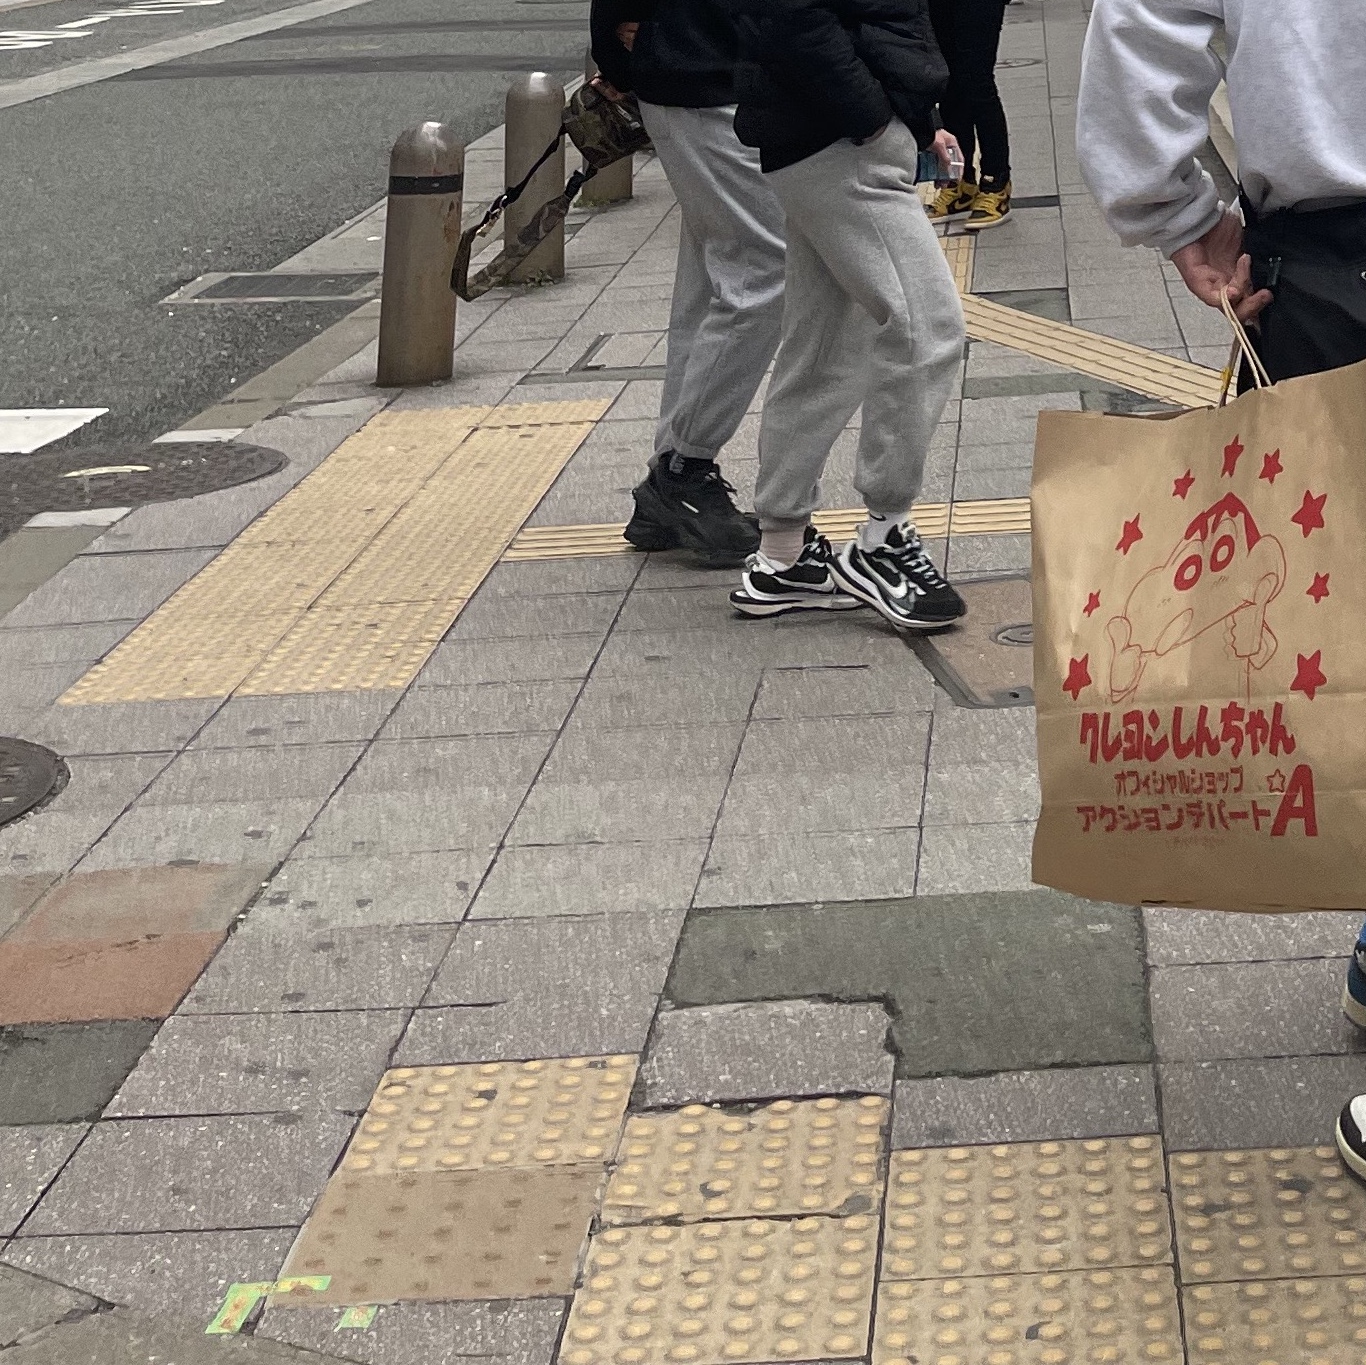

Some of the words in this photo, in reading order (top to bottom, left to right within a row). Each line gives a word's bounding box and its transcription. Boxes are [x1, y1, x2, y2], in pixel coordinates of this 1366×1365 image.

[1080, 701, 1296, 764] クレヨンしんちゃん
[1114, 765, 1243, 797] オフィシャルショップ
[1077, 799, 1271, 832] アクションデパート
